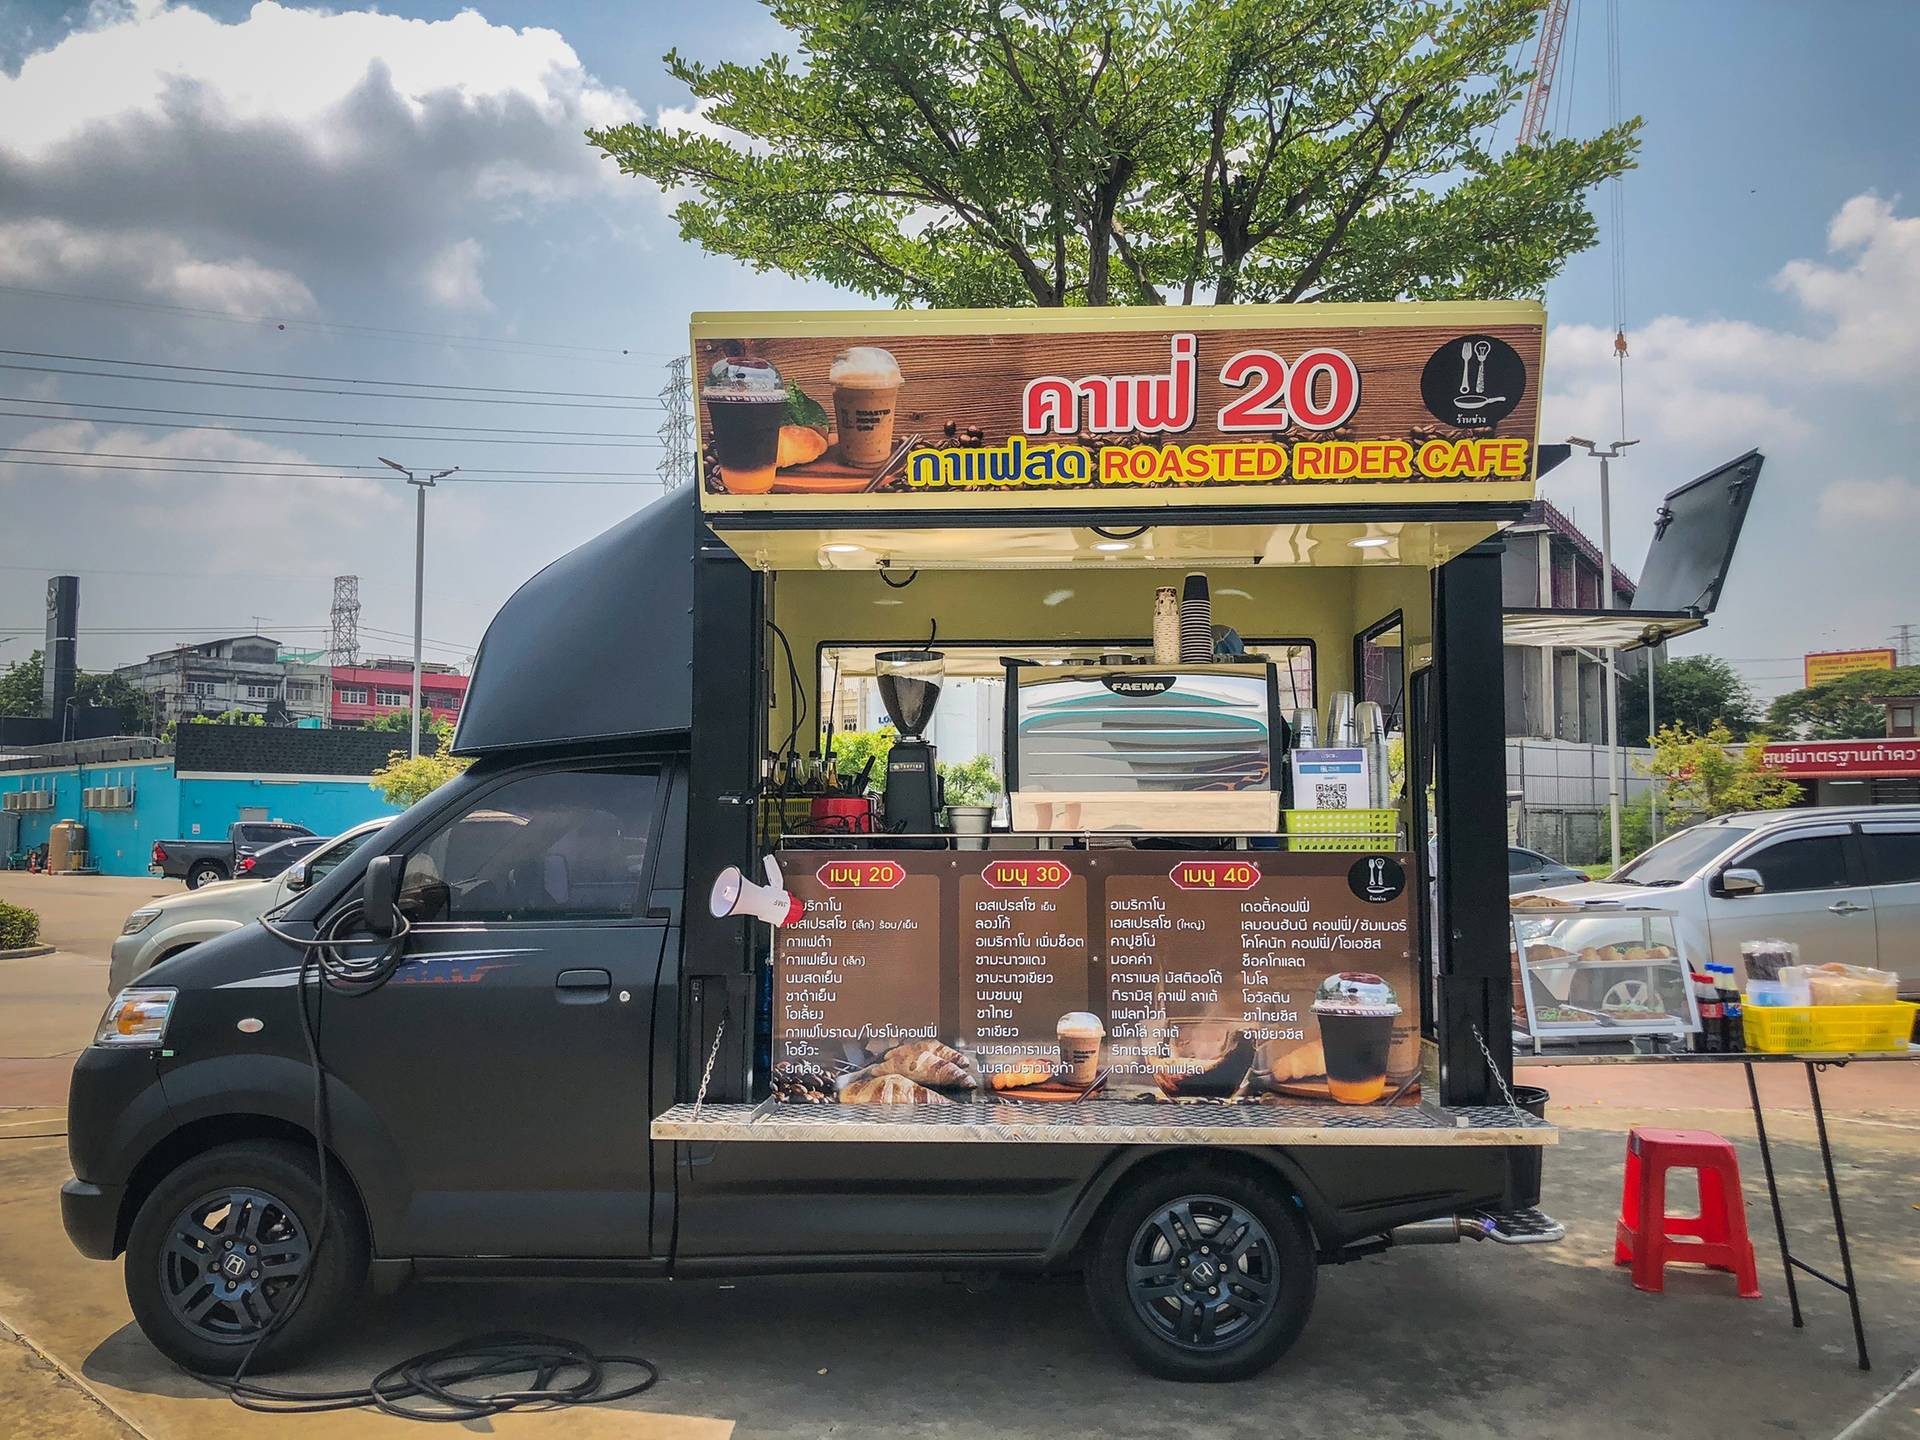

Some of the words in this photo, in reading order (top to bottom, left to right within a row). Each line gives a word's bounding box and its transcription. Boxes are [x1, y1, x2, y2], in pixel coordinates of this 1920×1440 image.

[1024, 335, 1195, 432] คาเฟ่
[1219, 349, 1358, 430] 20
[910, 438, 1088, 483] กาแฟสด
[1102, 447, 1284, 480] ROASTED
[1296, 445, 1409, 475] RIDER
[1421, 443, 1525, 474] CAFE
[1112, 682, 1166, 691] FAEMA
[830, 867, 861, 886] เมนู
[869, 867, 894, 882] 20
[997, 867, 1028, 886] เมนู
[1036, 867, 1060, 882] 30
[1184, 868, 1216, 887] เมนู
[1223, 868, 1251, 883] 40
[803, 897, 842, 911] ริกาโน
[1110, 896, 1166, 911] อเมริกาโน
[975, 914, 1011, 929] ลองโก้
[786, 935, 832, 948] กาแฟดำ
[975, 932, 1031, 947] อเมริกาโน
[1036, 931, 1084, 947] เพิ่มช็อต
[786, 952, 838, 966] กาแฟเย็น
[975, 955, 1046, 966] ชามะนาวแดง
[1110, 952, 1153, 965] มอคค่า
[1242, 952, 1306, 967] ช็อคโกแลต
[785, 970, 843, 984] นมสดเย็น
[975, 971, 1054, 984] ชามะนาวเขียว
[1111, 972, 1160, 984] คาราเมล
[1241, 970, 1269, 985] ไมโล
[785, 988, 836, 1001] ชาดำเย็น
[976, 990, 1023, 1004] นมชมพู
[1157, 990, 1186, 1002] คาเฟ่
[1190, 989, 1218, 1002] ลาเต้
[1242, 988, 1290, 1004] โอวัลติน
[785, 1004, 824, 1020] โอเลี้ยง
[976, 1004, 1013, 1019] ชาไทย
[976, 1024, 1019, 1037] ชาเขียว
[1152, 1026, 1179, 1038] ลาเต้
[976, 1045, 1061, 1055] นมสดคาราเมล
